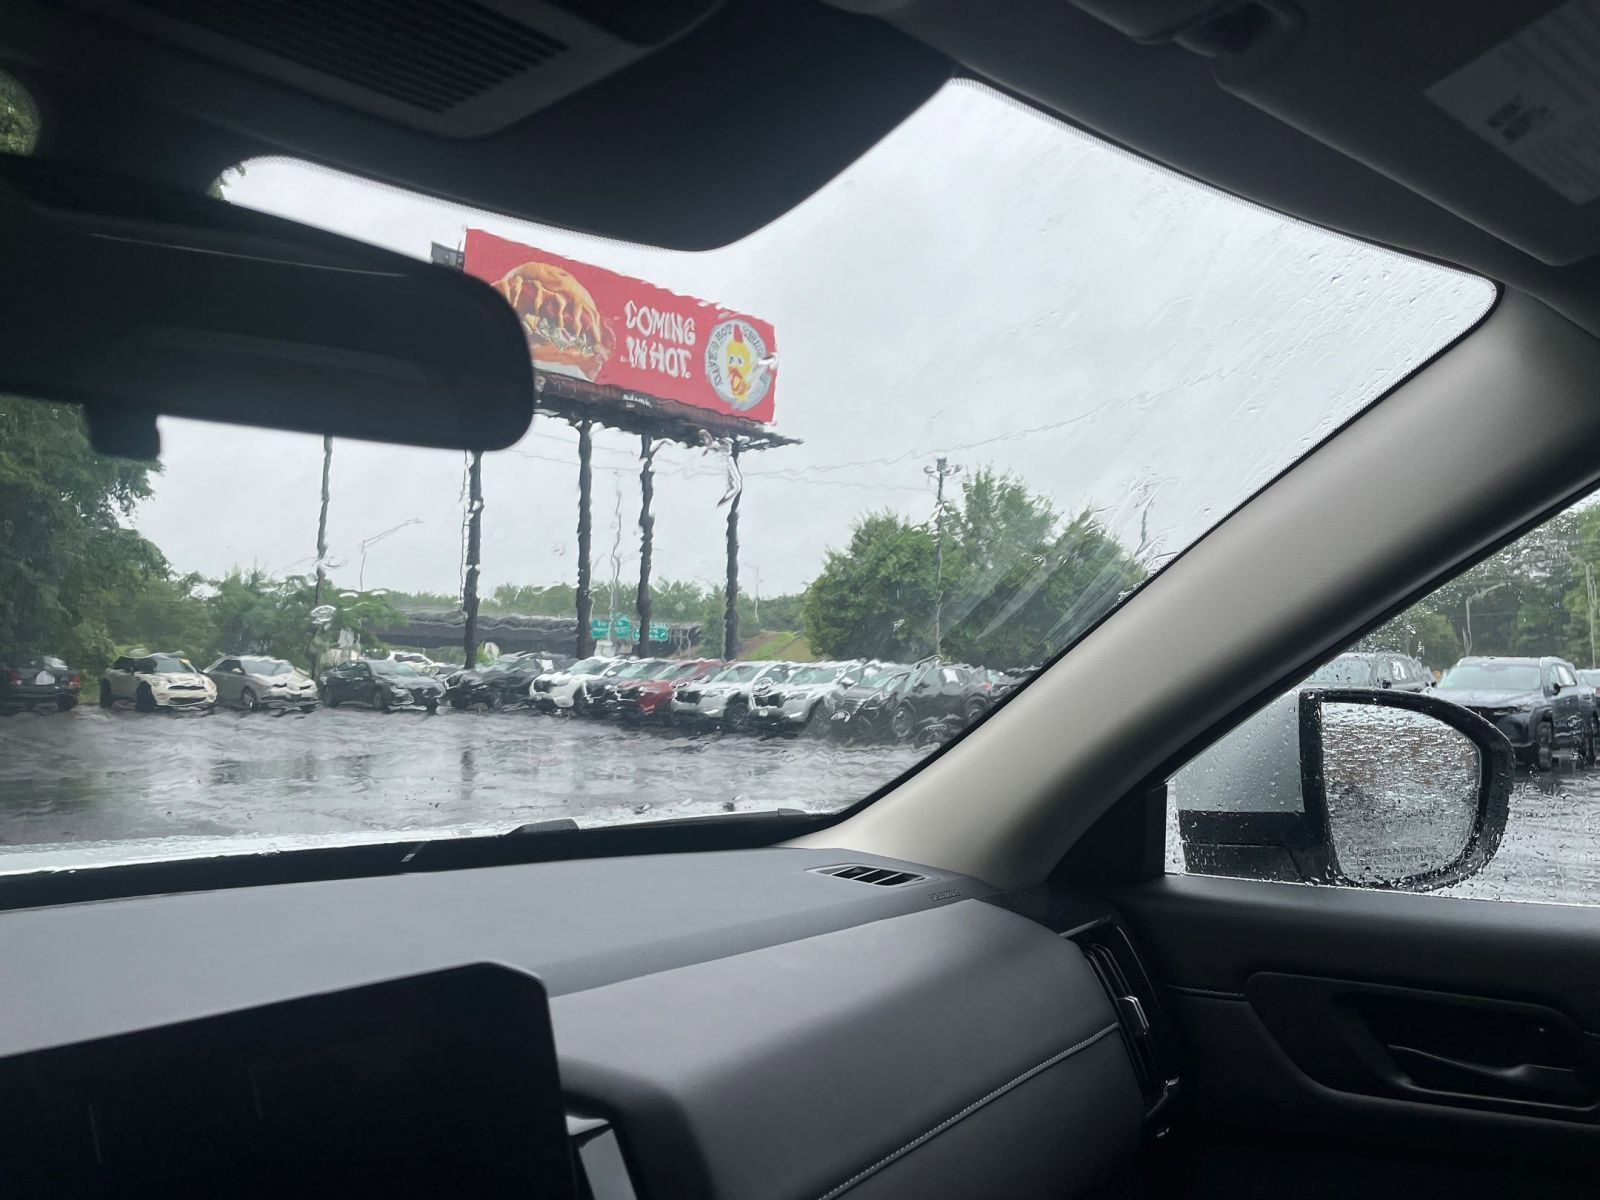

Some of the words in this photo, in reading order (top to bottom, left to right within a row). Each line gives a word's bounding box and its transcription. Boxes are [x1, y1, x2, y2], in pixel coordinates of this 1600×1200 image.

[624, 300, 696, 346] COMING
[715, 323, 733, 341] HOT
[626, 336, 648, 370] IN
